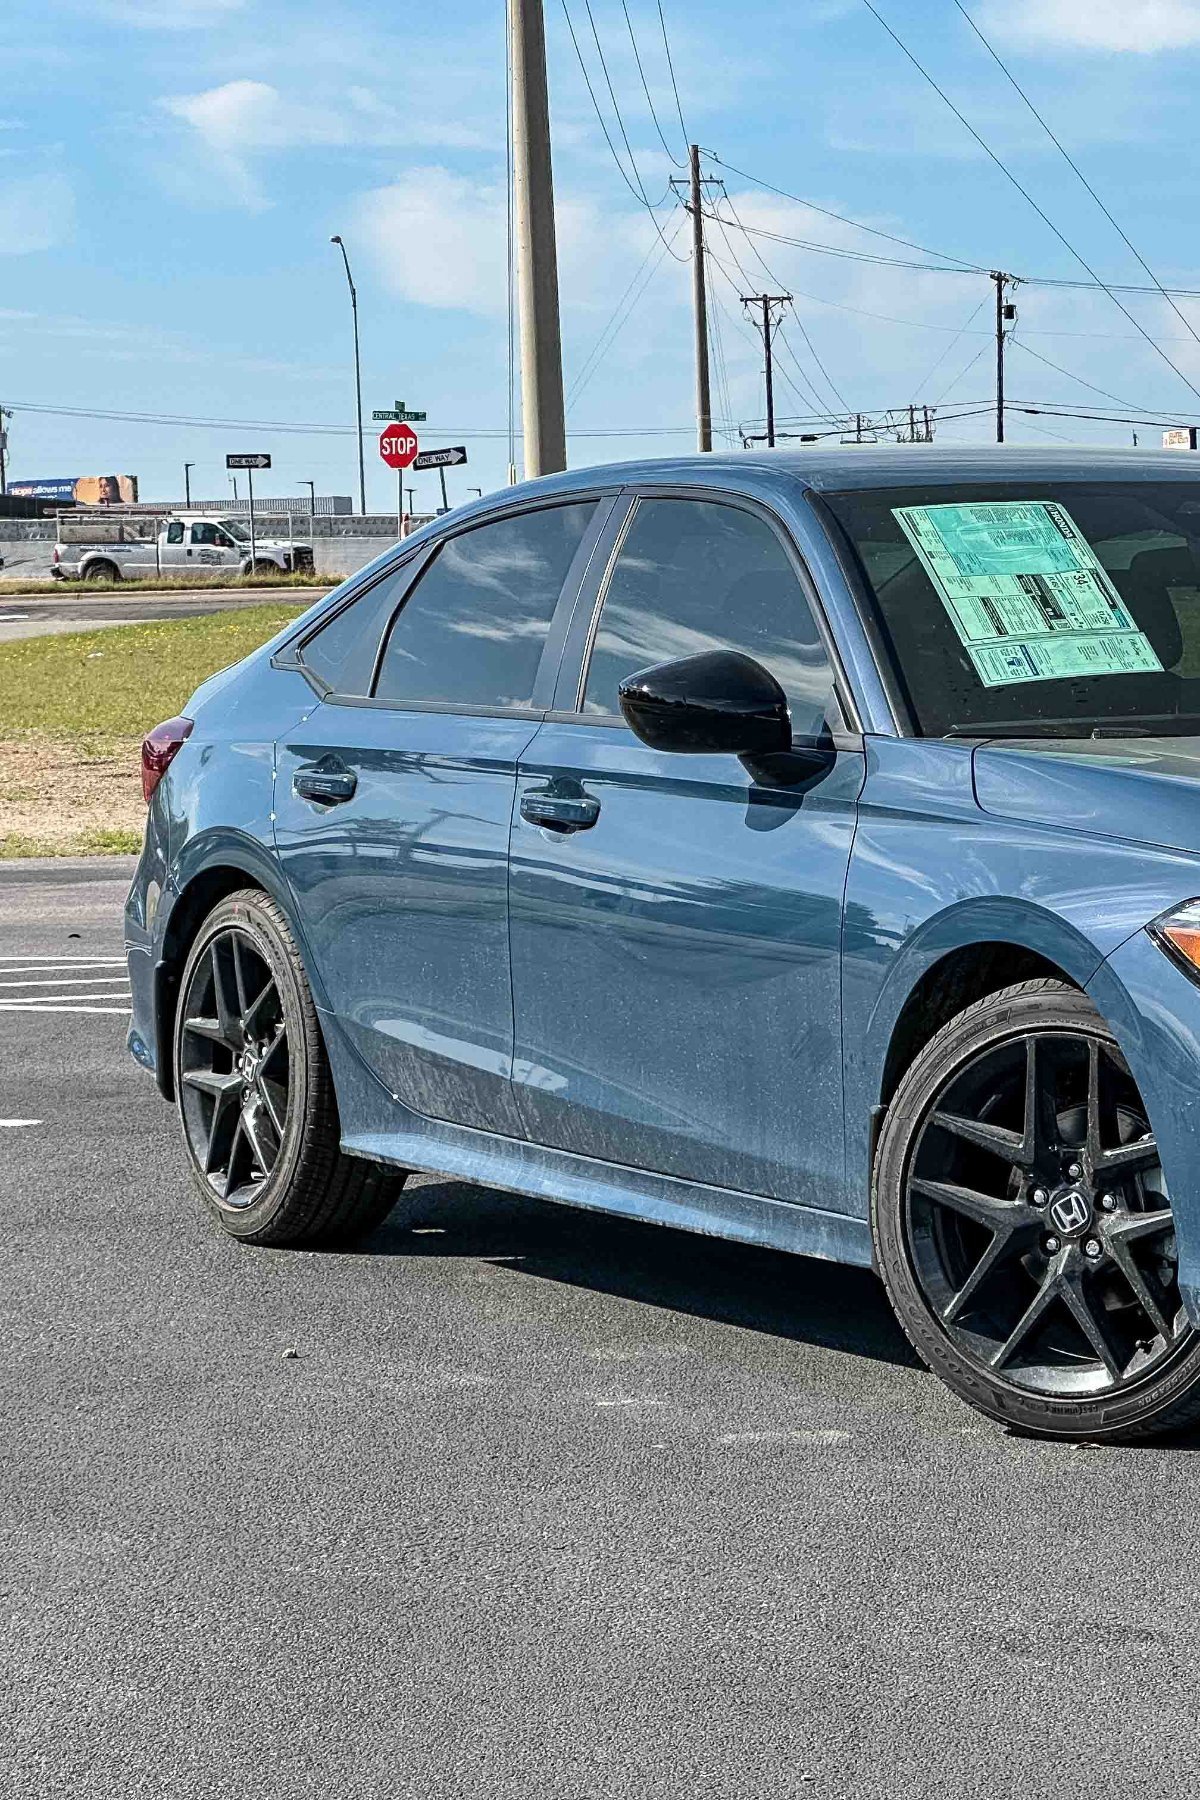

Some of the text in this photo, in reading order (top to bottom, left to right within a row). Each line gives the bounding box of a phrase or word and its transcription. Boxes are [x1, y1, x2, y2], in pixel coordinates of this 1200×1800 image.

[373, 412, 396, 420] CENTRAL
[398, 412, 415, 420] TEXAS
[382, 437, 415, 455] STOP
[418, 454, 450, 465] ONE WAY
[1051, 510, 1073, 538] HONDA
